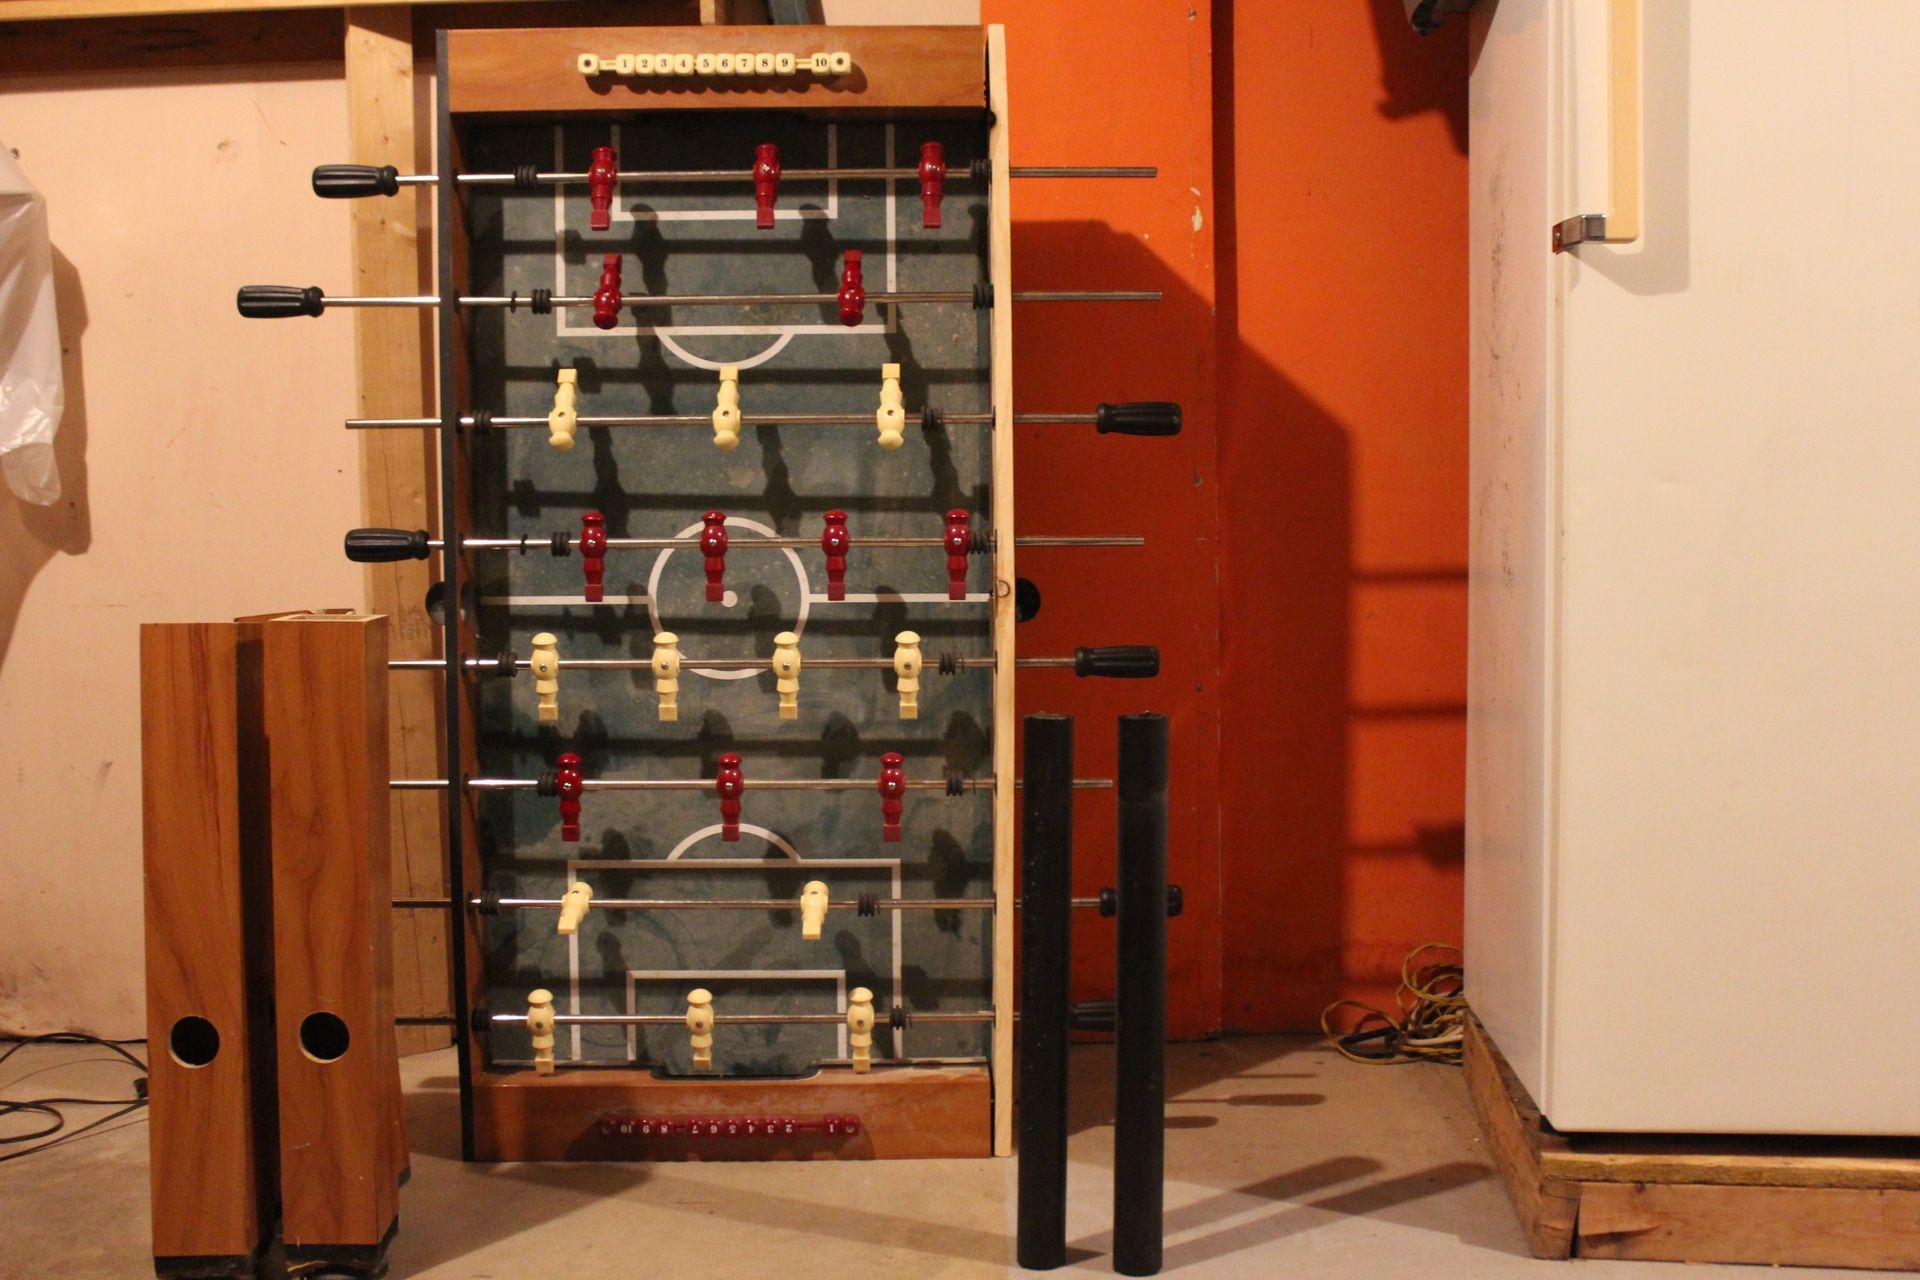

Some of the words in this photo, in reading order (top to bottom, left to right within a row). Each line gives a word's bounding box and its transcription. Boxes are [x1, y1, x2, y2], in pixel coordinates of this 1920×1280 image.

[641, 59, 649, 68] 2
[660, 59, 668, 68] 3
[679, 58, 687, 68] 4
[702, 58, 710, 68] 5
[721, 58, 729, 68] 6
[740, 58, 748, 68] 7
[761, 58, 769, 68] 8
[781, 57, 789, 68] 9
[815, 57, 828, 68] 10
[620, 1124, 633, 1134] 10
[660, 1124, 669, 1134] 8
[691, 1124, 699, 1134] 7
[728, 1124, 737, 1134] 5
[747, 1124, 756, 1134] 4
[766, 1124, 775, 1134] 3
[785, 1124, 793, 1134] 2
